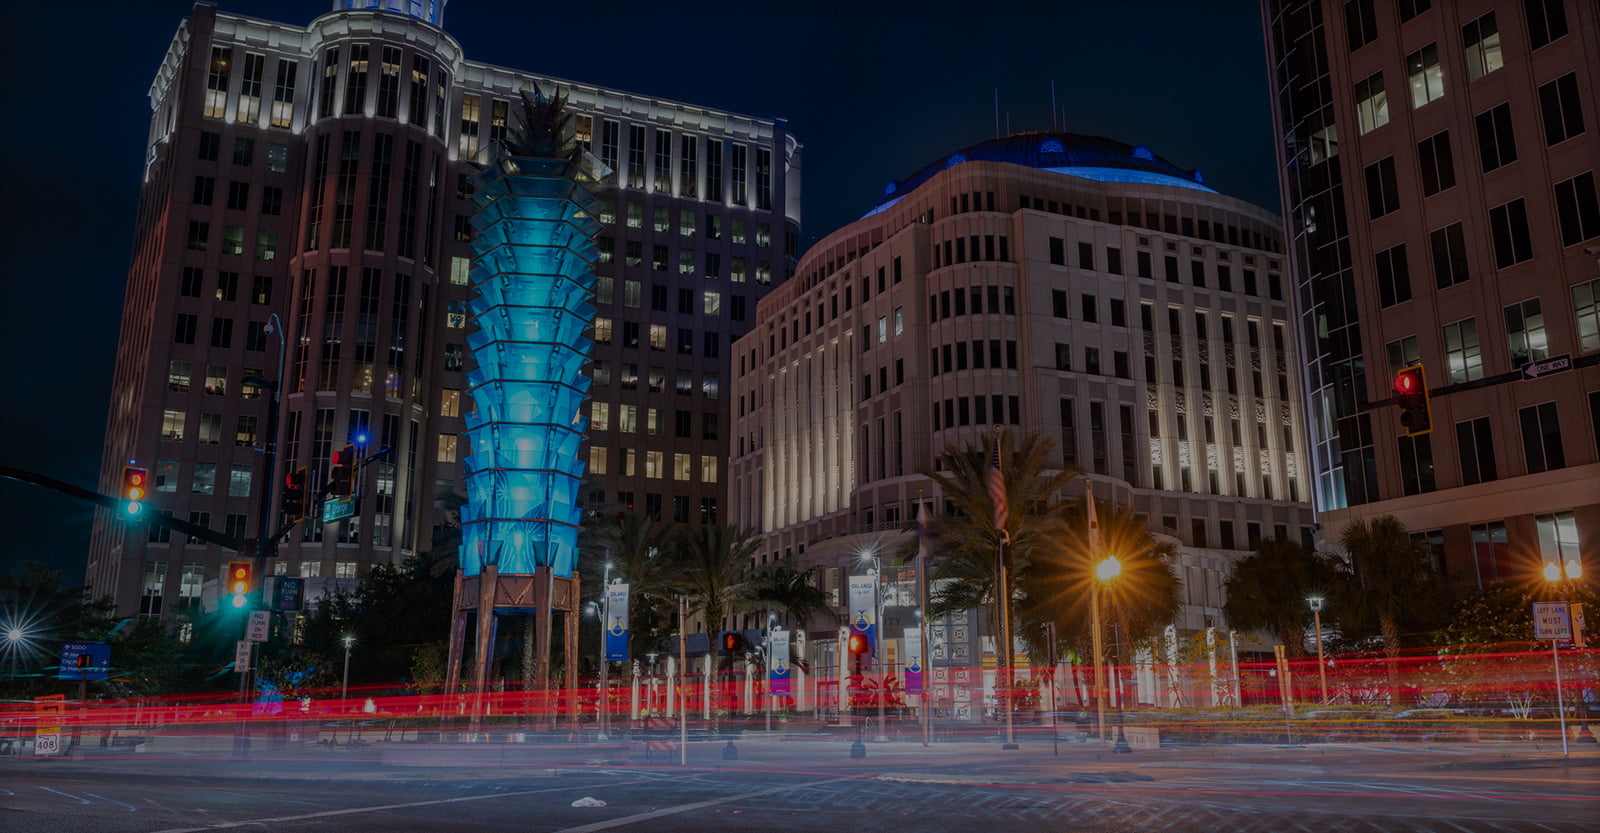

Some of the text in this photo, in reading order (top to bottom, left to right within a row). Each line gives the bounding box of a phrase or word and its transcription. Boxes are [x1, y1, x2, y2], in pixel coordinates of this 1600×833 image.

[1536, 359, 1567, 373] ONE WAY
[283, 581, 296, 589] NO
[281, 588, 298, 596] TURN
[883, 617, 902, 626] ITY
[1542, 616, 1561, 625] MUST
[37, 740, 55, 750] 408
